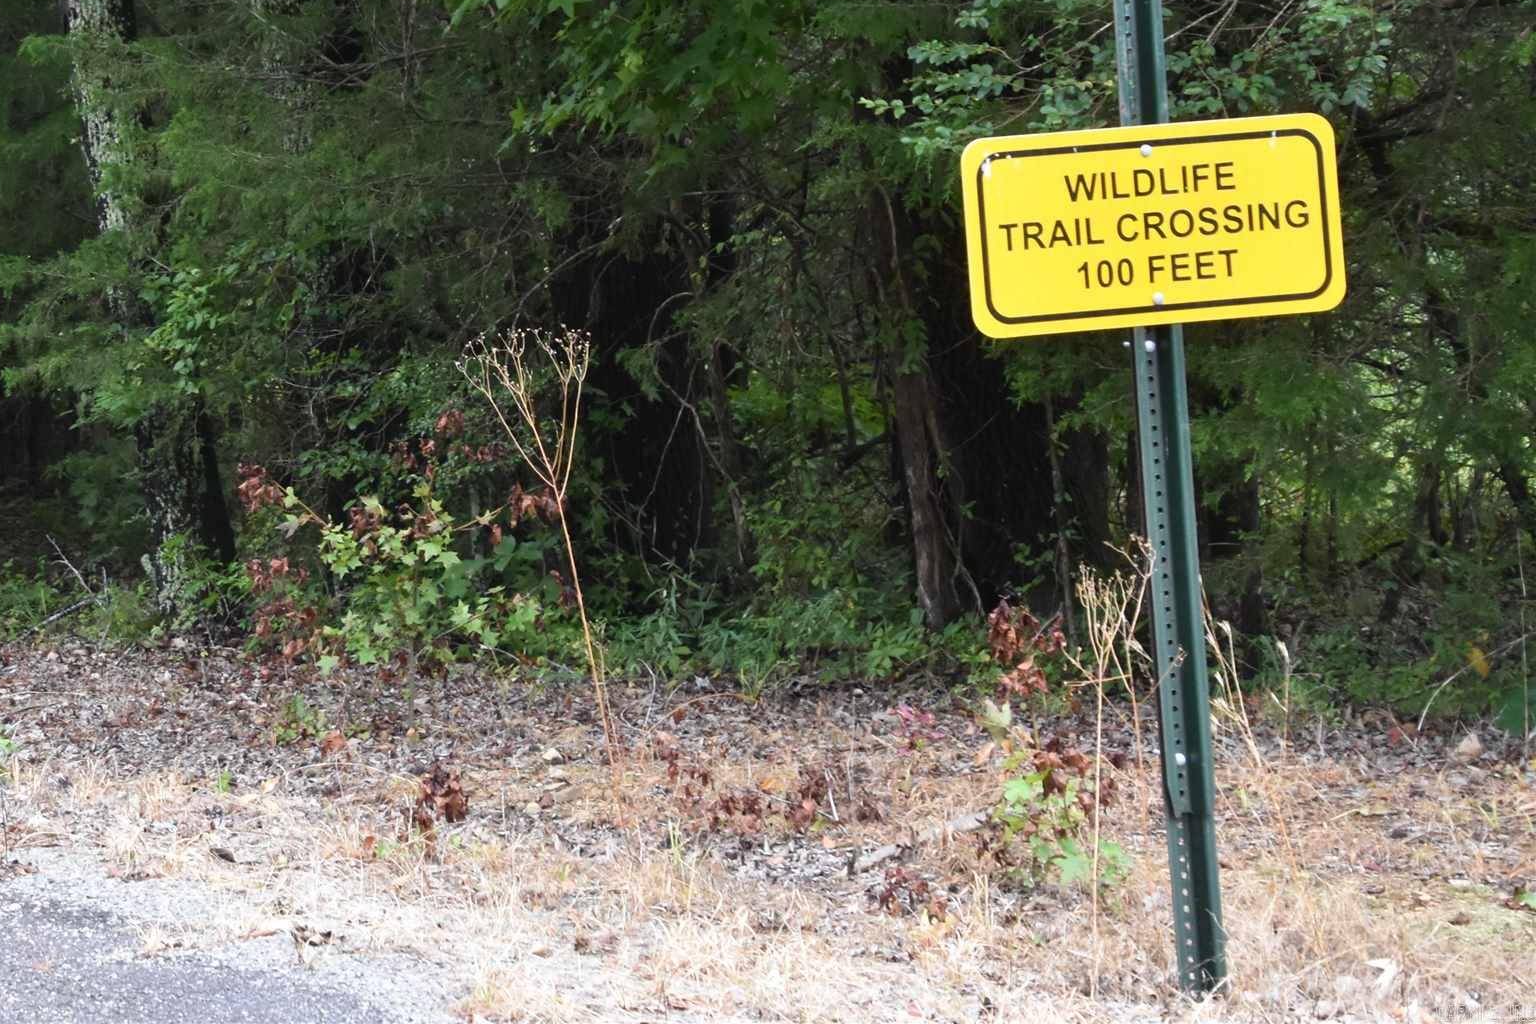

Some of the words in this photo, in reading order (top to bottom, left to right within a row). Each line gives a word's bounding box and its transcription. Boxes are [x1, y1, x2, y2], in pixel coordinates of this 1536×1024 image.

[1063, 162, 1236, 202] WILDLIFE
[998, 217, 1105, 251] TRAIL
[1116, 199, 1310, 242] CROSSING
[1077, 258, 1134, 289] 100
[1148, 249, 1238, 284] FEET
